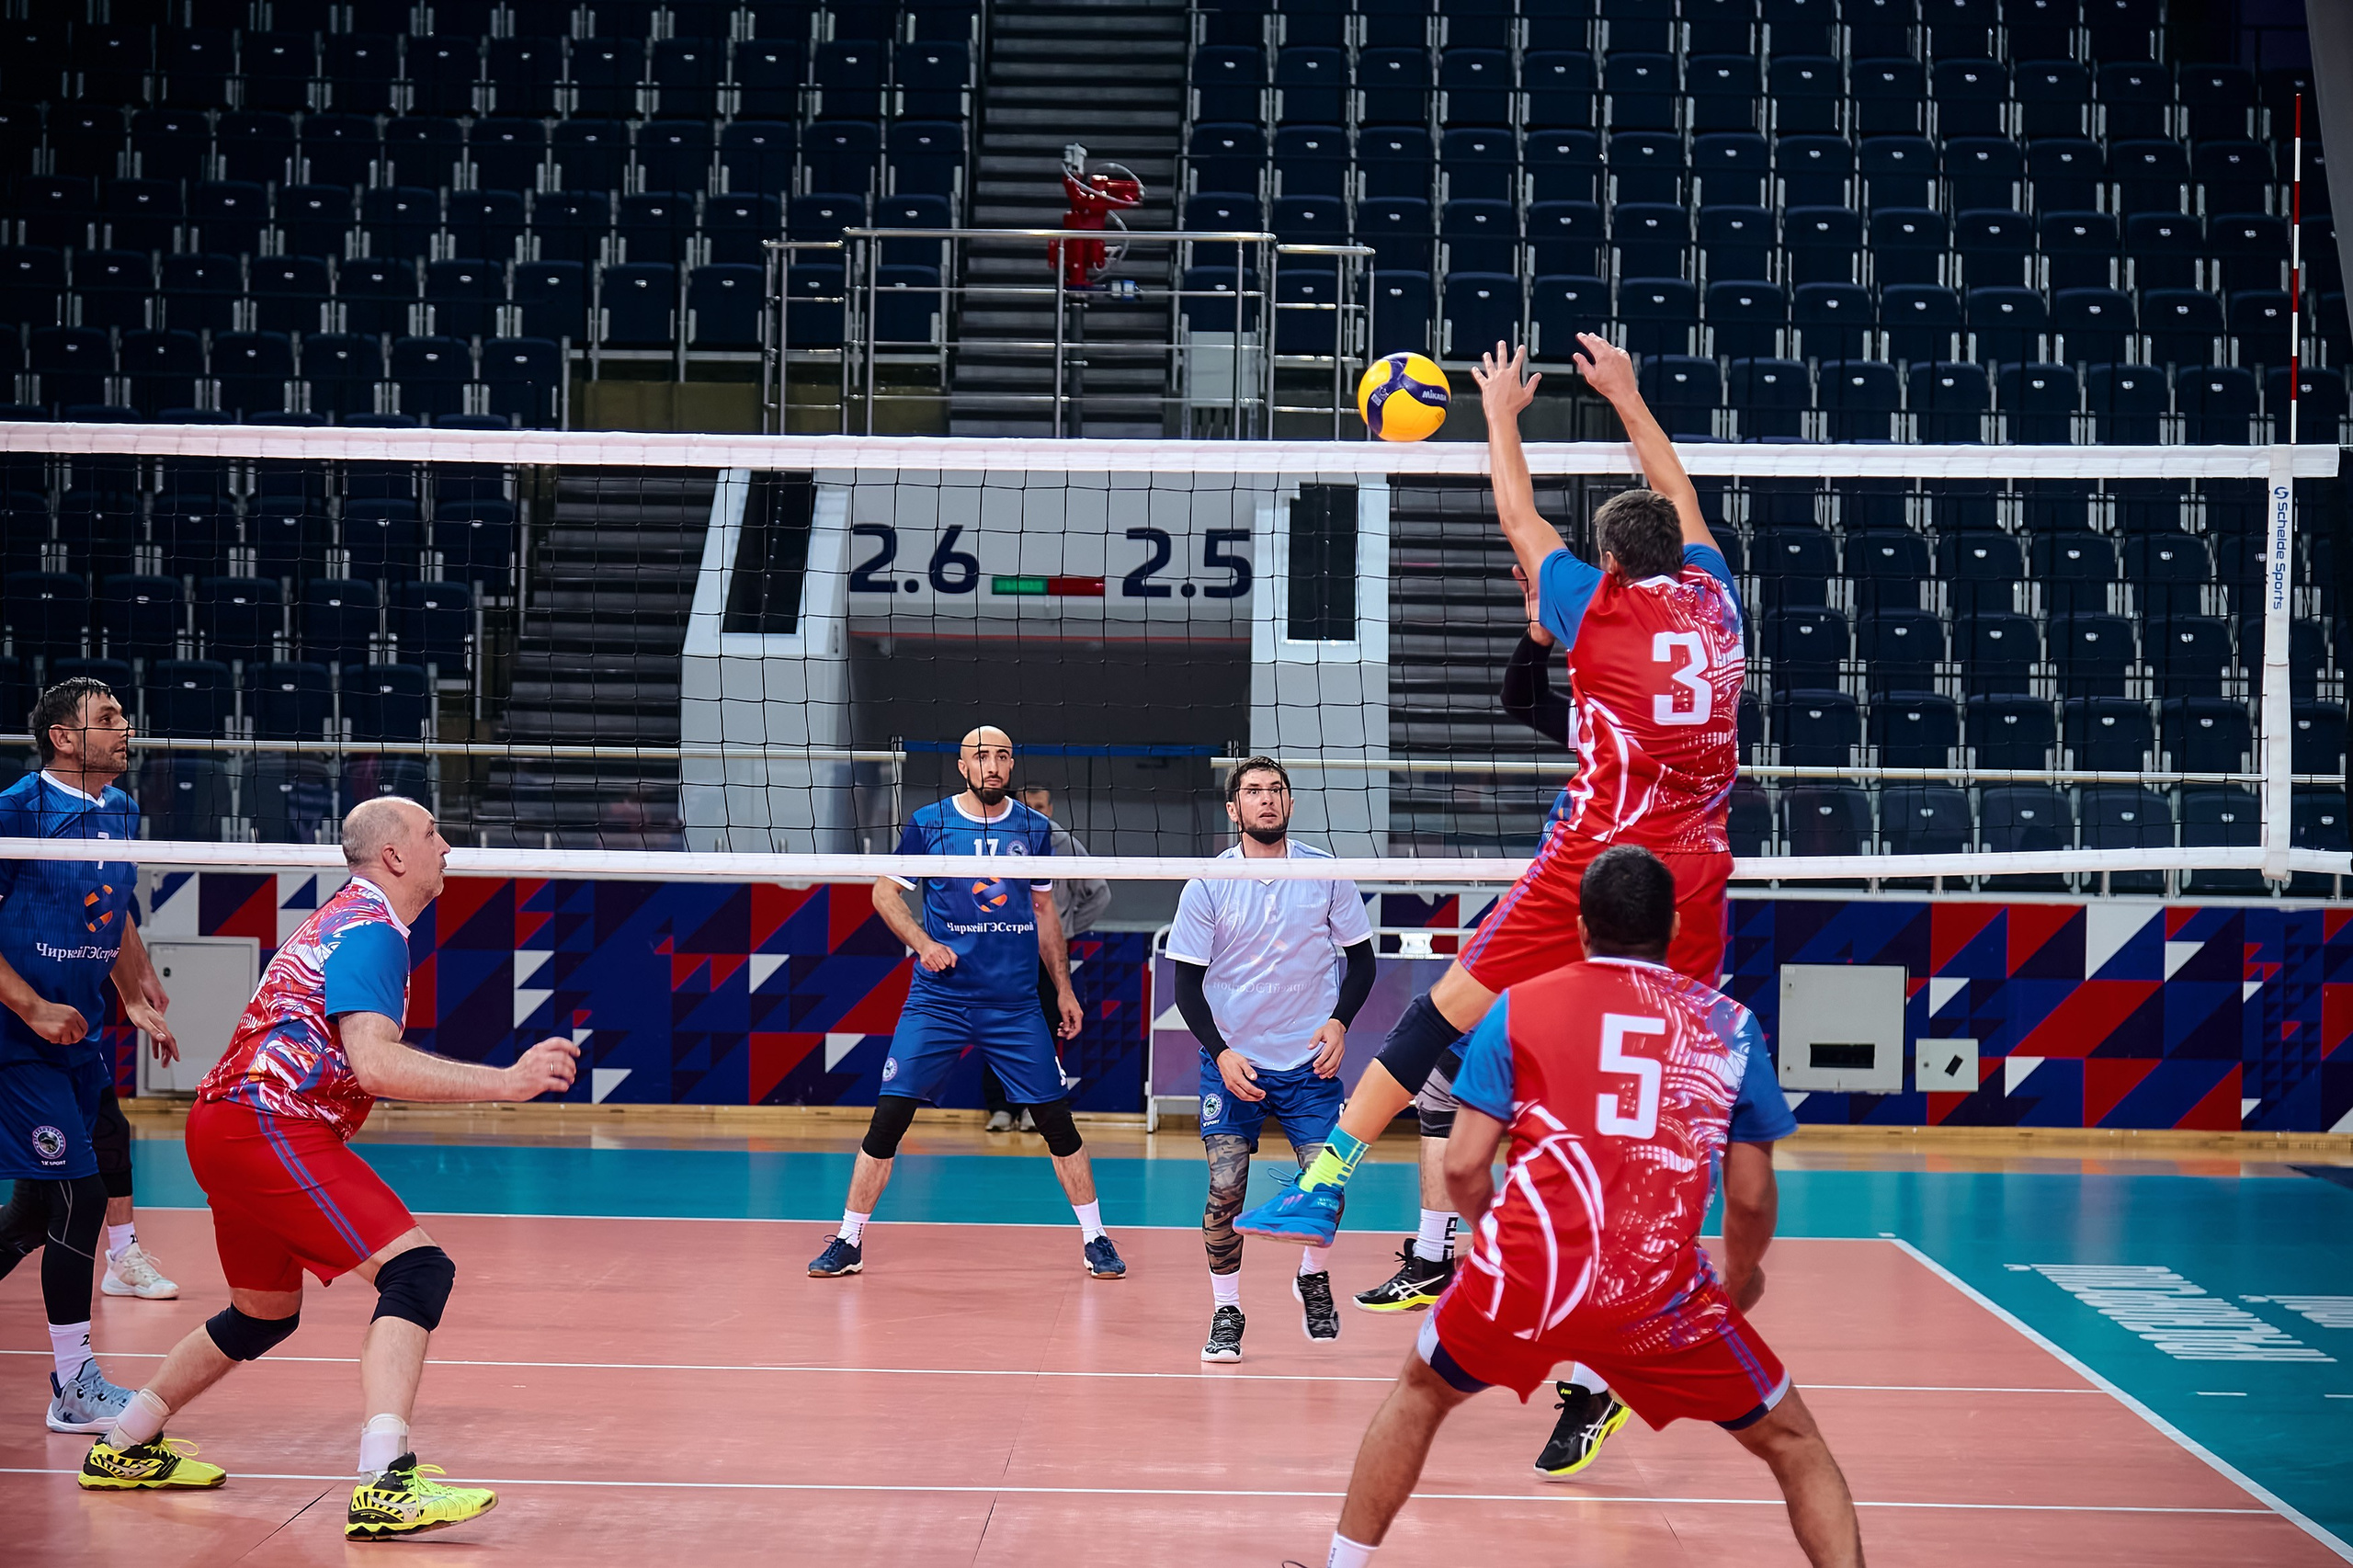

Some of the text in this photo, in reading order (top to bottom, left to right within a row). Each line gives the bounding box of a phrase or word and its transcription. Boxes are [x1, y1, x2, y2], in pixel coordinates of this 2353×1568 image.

[848, 523, 980, 594] 2.6
[1121, 527, 1253, 598] 2.5
[2272, 502, 2289, 610] Schelde Sports
[1652, 631, 1713, 726] 3
[973, 838, 1000, 857] 17
[1595, 1013, 1665, 1140] 5
[2003, 1262, 2338, 1362] КРАСНОЯРСКИЙ
